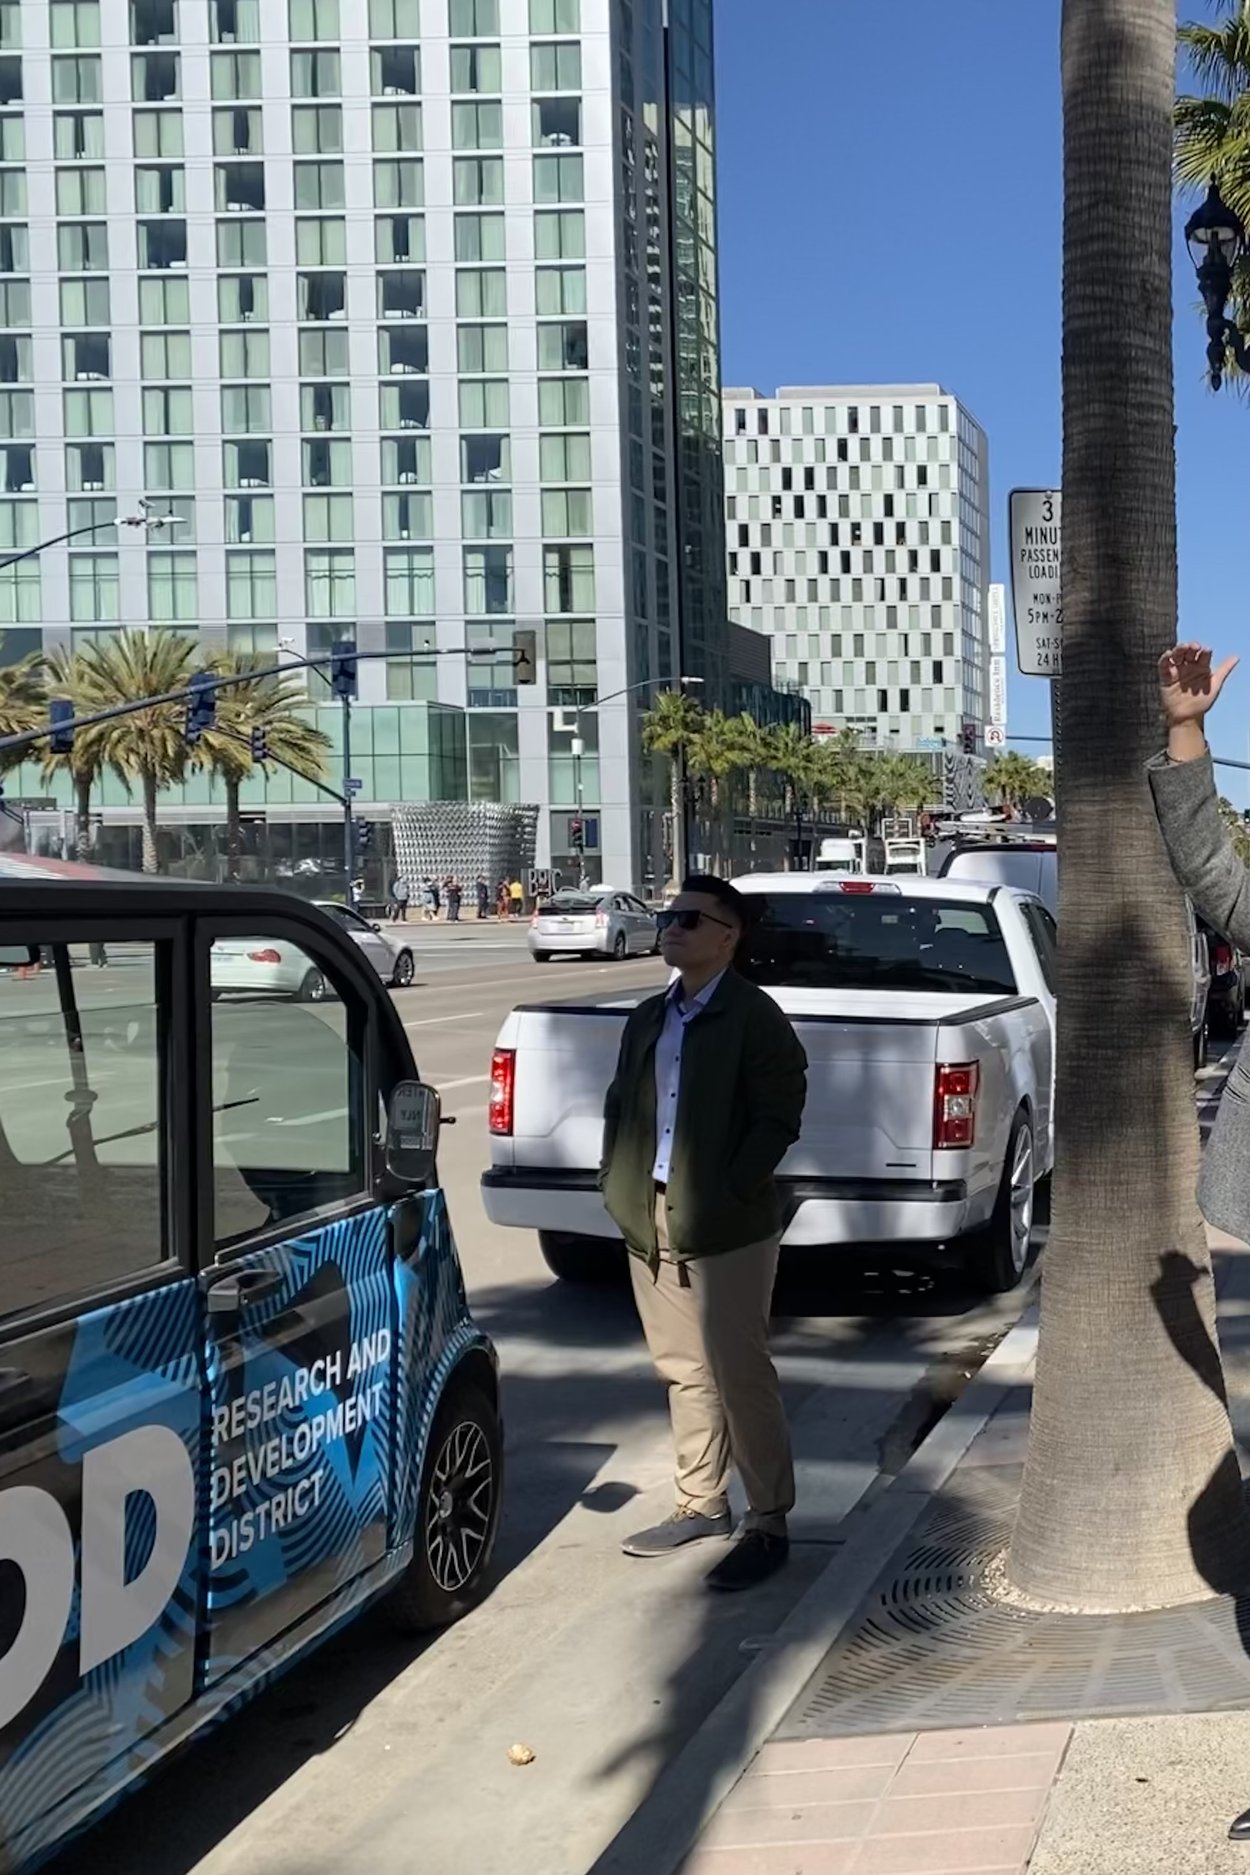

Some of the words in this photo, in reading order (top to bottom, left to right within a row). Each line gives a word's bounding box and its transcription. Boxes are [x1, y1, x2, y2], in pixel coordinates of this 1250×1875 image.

[1042, 500, 1053, 522] 3
[1025, 526, 1062, 545] MINU
[1020, 548, 1063, 562] PASSEN
[1029, 565, 1060, 579] LOADI
[1033, 593, 1063, 605] MON-F
[1028, 609, 1064, 624] 5PM-2
[1037, 653, 1049, 667] 24
[1052, 654, 1063, 667] H
[212, 1351, 341, 1447] RESEARCH
[346, 1328, 391, 1380] AND
[211, 1382, 384, 1508] DEVELOPMENT
[209, 1469, 324, 1571] DISTRICT
